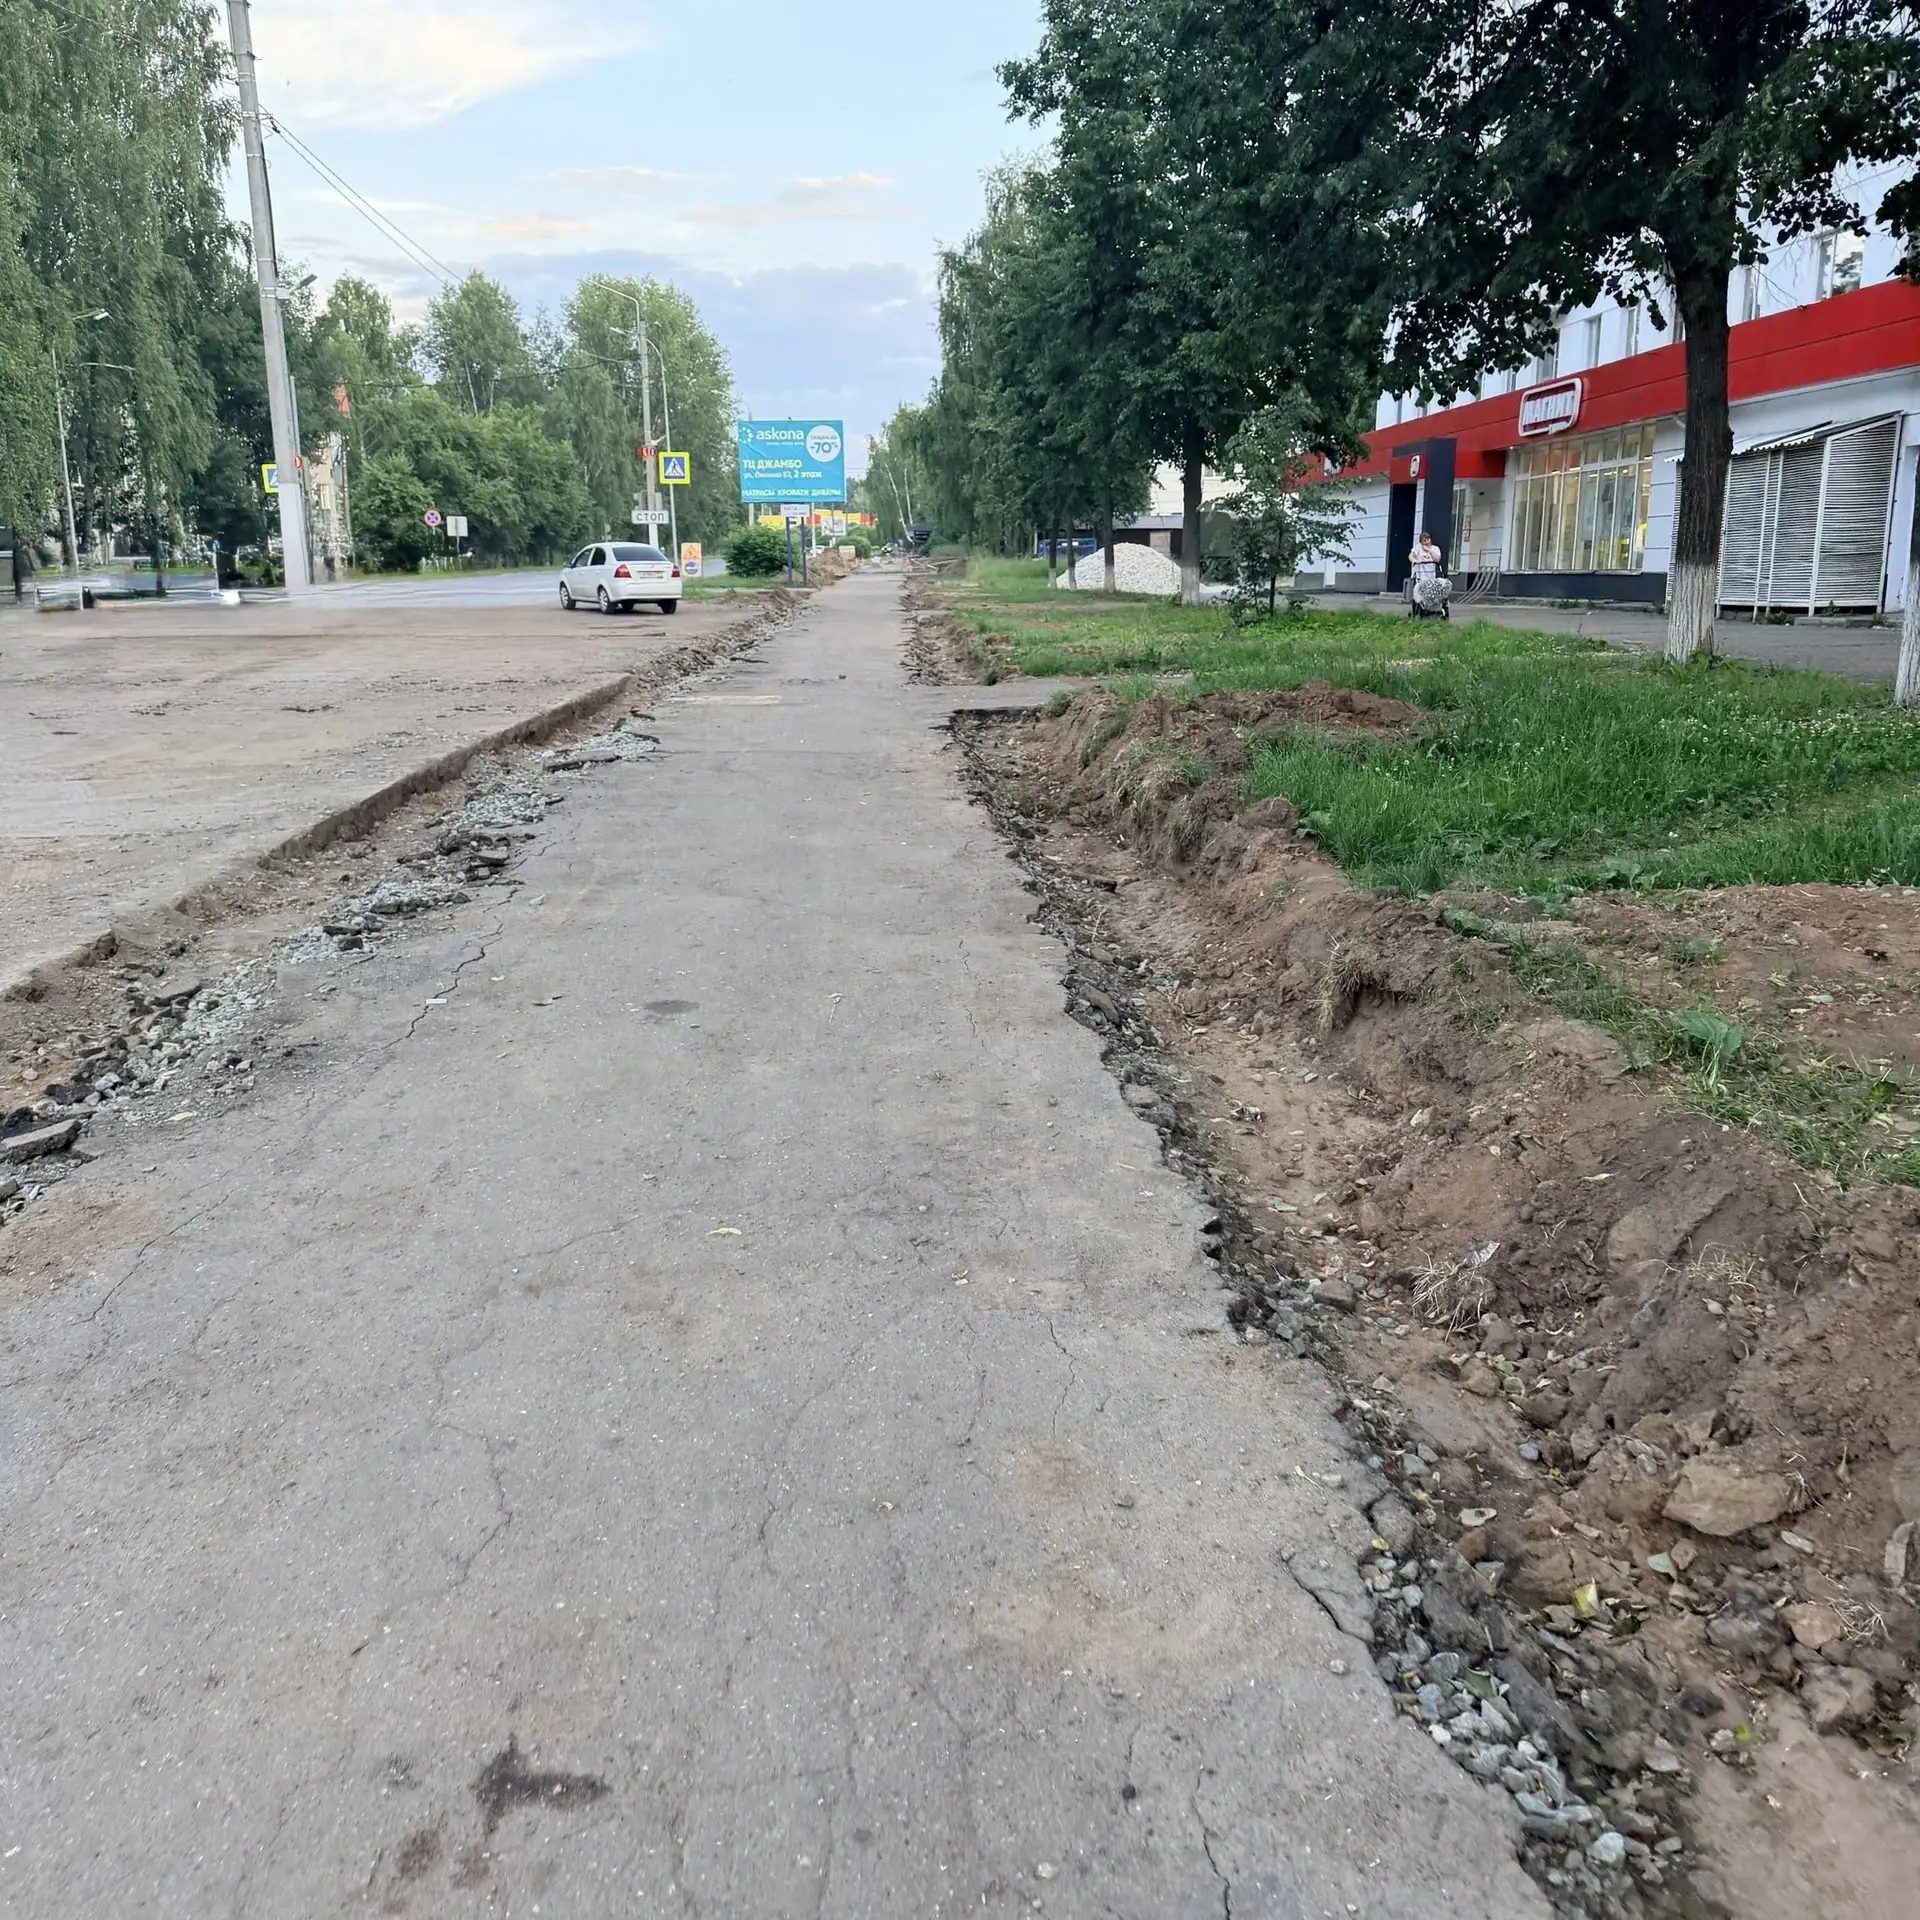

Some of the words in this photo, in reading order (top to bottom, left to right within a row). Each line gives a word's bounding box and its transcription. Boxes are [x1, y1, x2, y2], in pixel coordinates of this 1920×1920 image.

[1522, 390, 1576, 426] МАГНИТ
[756, 427, 804, 440] askona
[743, 460, 756, 470] ТЦ
[757, 459, 802, 470] ДЖАМБО
[793, 470, 800, 478] 2
[636, 513, 664, 521] СТОП
